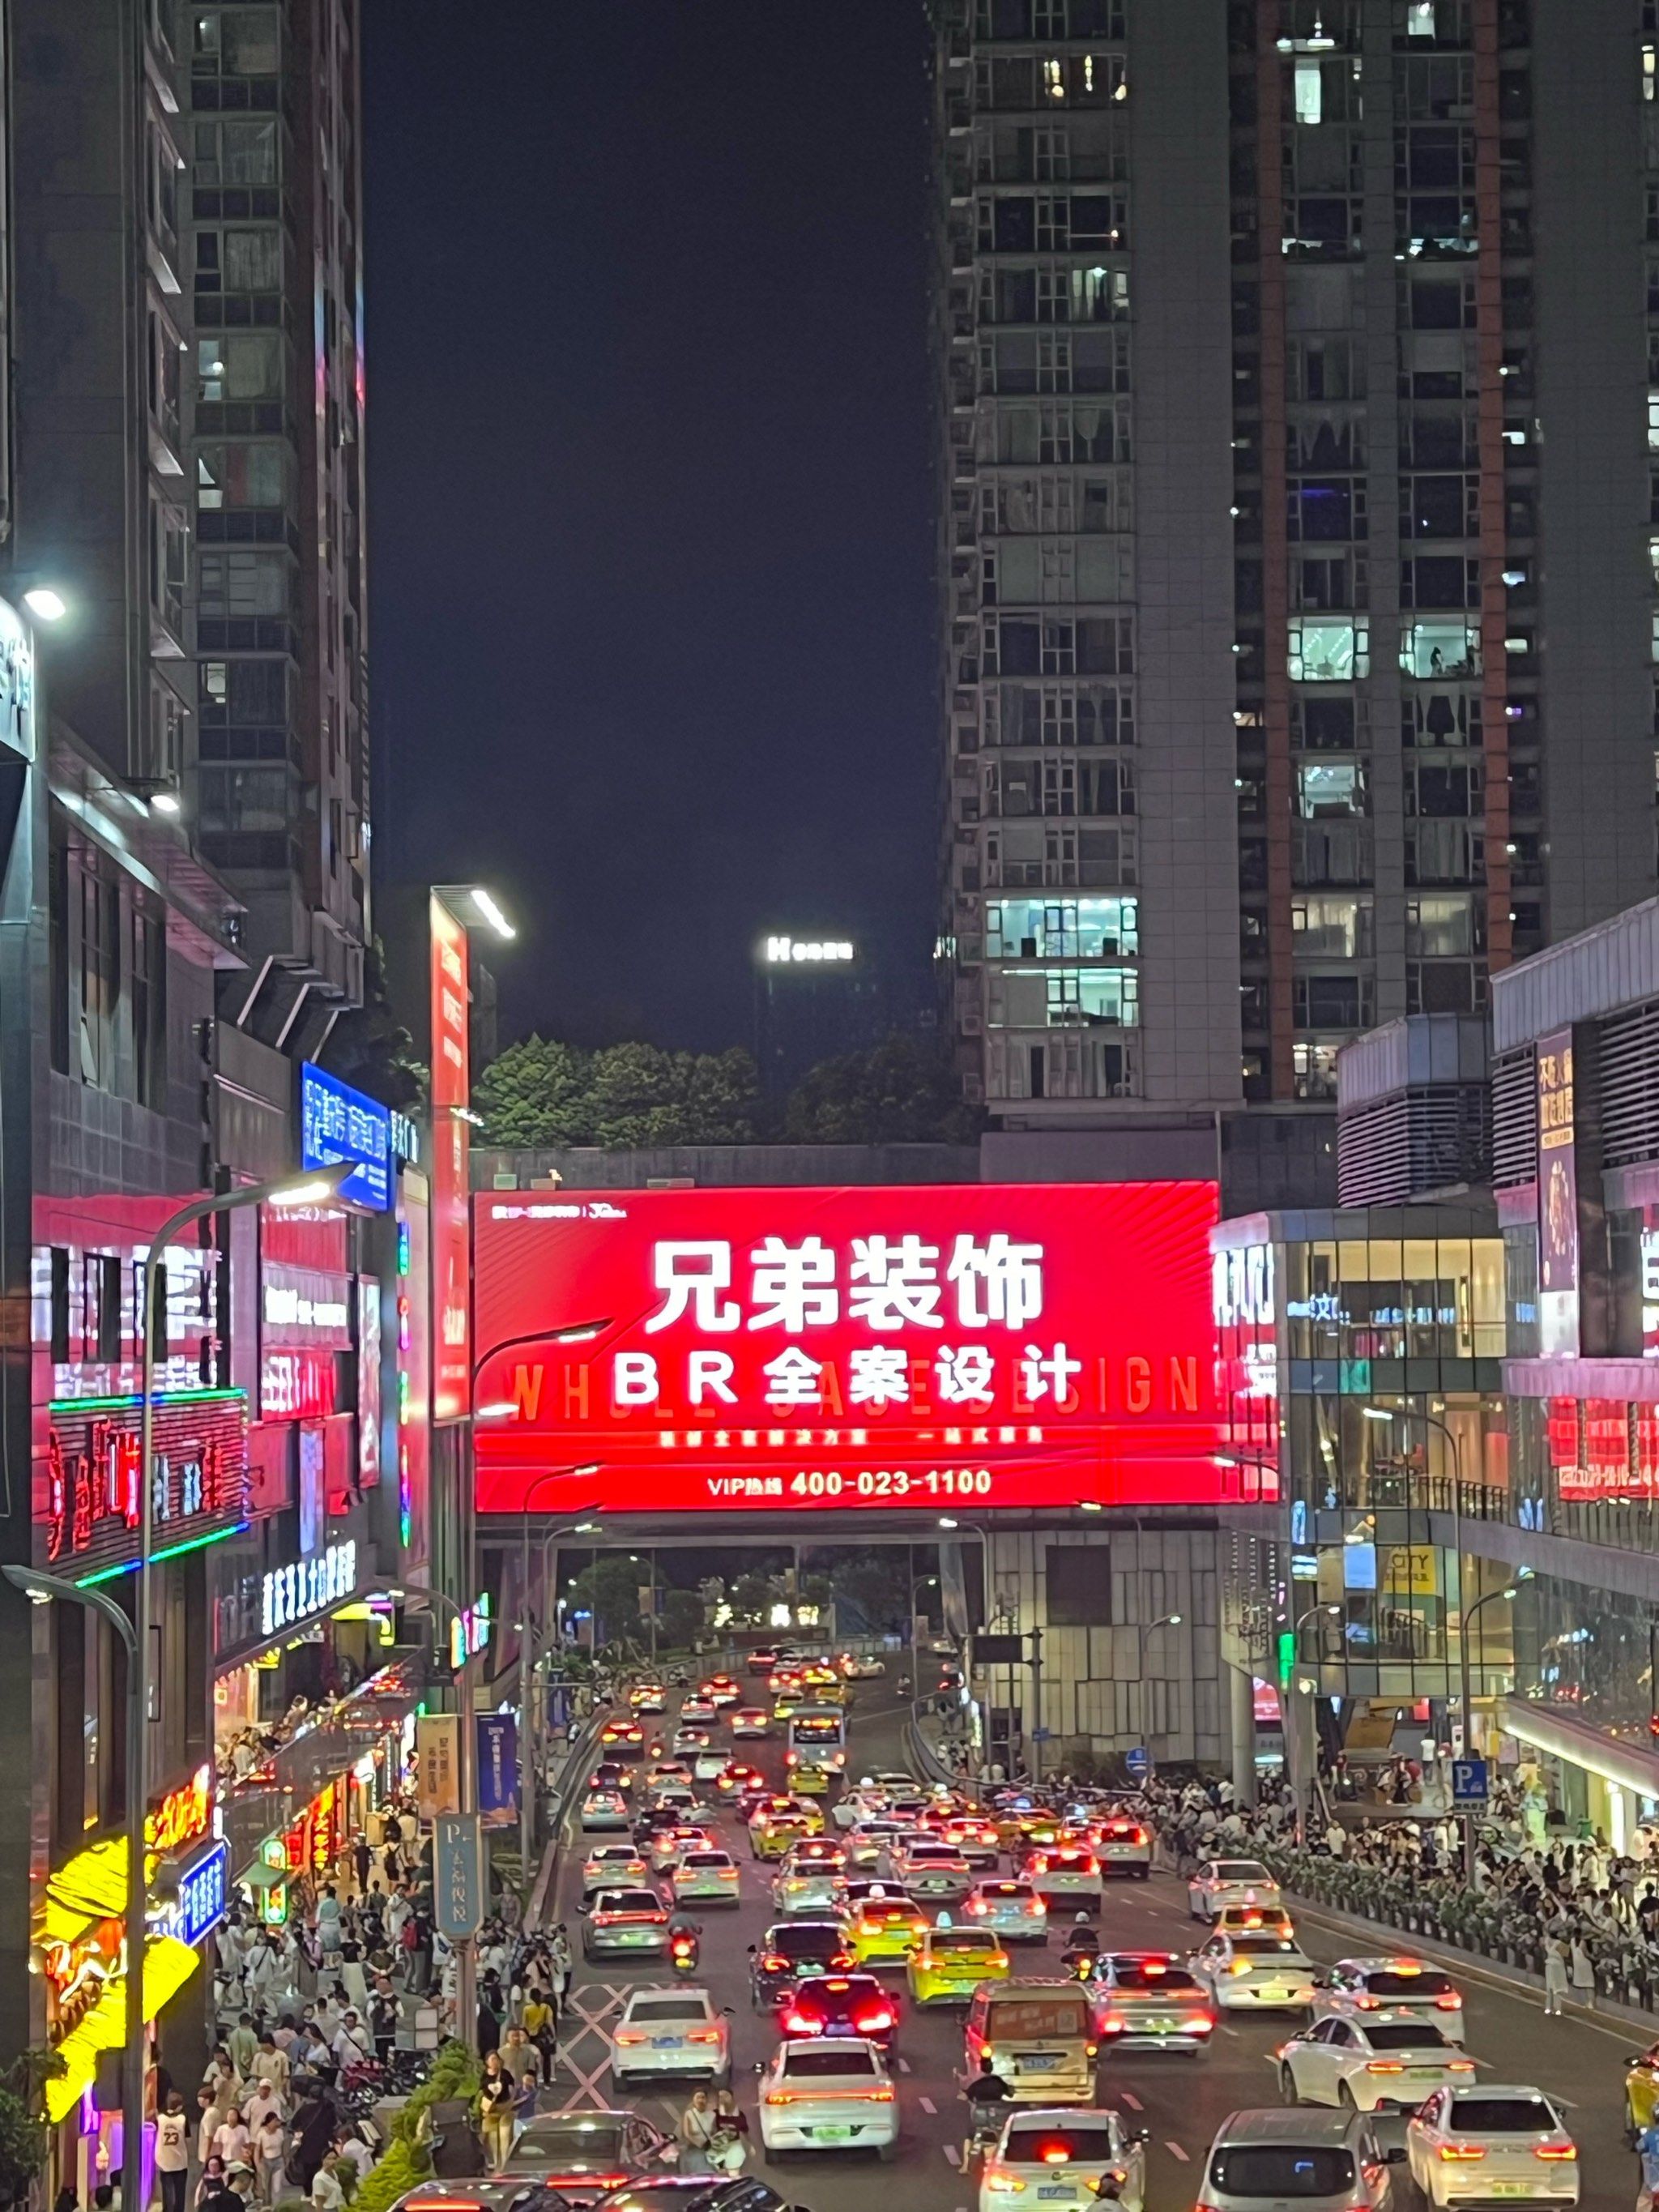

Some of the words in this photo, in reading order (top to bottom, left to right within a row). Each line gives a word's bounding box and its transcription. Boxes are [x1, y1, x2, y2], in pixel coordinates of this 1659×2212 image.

[645, 1233, 1044, 1333] 兄弟装饰
[790, 1470, 992, 1496] 400-023-1100
[1456, 1766, 1473, 1793] P
[164, 2132, 180, 2146] 23
